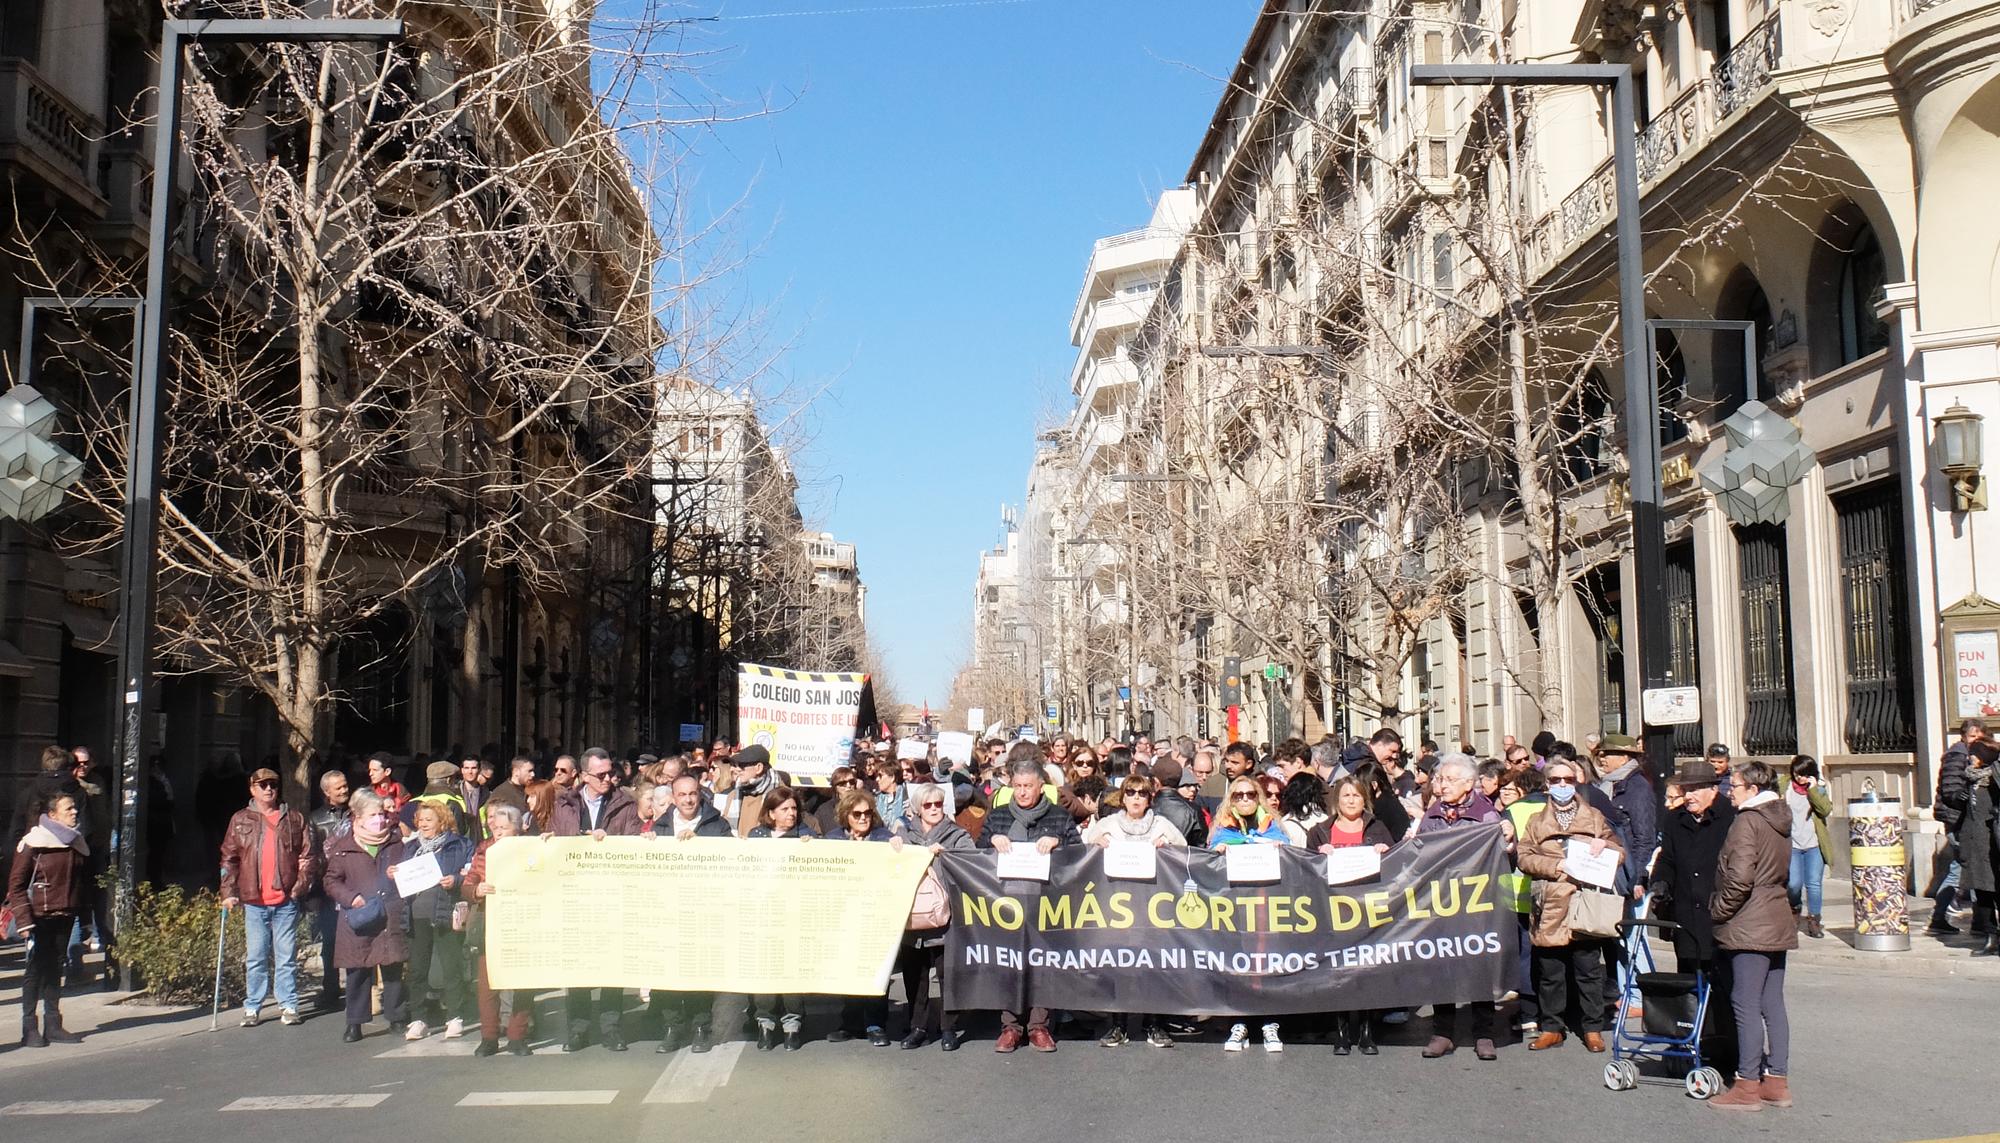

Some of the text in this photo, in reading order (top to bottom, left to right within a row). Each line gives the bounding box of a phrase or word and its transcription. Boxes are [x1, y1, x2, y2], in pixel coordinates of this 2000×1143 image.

[1958, 650, 1985, 662] FUN
[1960, 668, 1978, 678] DA
[752, 682, 801, 704] COLEGIO
[806, 690, 831, 706] SAN
[770, 708, 787, 724] LOS
[790, 712, 828, 726] CORTES
[832, 714, 844, 726] DE
[784, 743, 798, 751] NO
[605, 852, 638, 860] Cortes!
[646, 852, 684, 862] ENDESA
[687, 854, 726, 863] culpable
[737, 854, 786, 862] Gobierns
[788, 855, 857, 865] Responsables.
[961, 892, 1024, 931] NO
[1038, 880, 1135, 932] MÁS
[1328, 890, 1394, 932] DE
[1404, 873, 1494, 920] LUZ
[966, 932, 1502, 974] NI EN GRANADA NI EN OTROS TERRITORIOS
